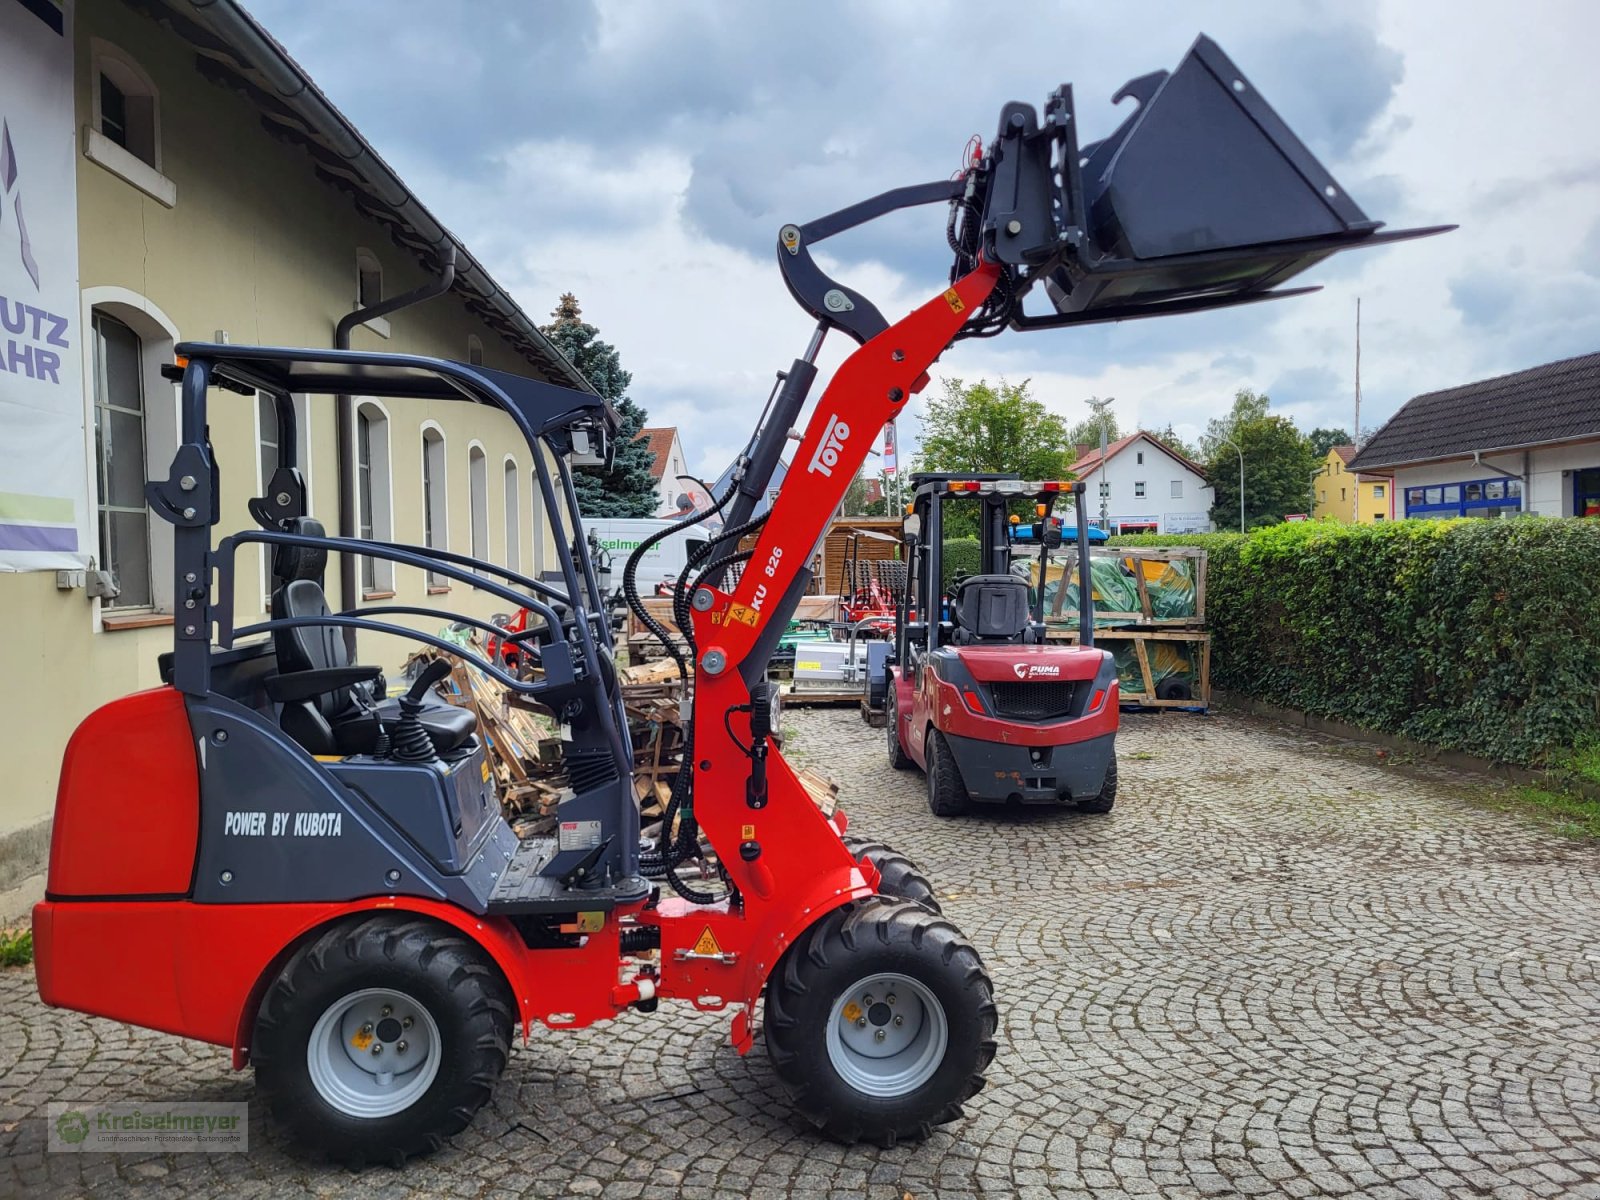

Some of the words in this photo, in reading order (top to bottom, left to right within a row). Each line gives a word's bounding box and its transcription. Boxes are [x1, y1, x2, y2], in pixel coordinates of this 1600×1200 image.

[0, 339, 60, 385] HR
[751, 584, 767, 612] KU
[765, 546, 783, 577] 826
[225, 812, 267, 836] POWER
[271, 812, 290, 836] BY
[294, 812, 342, 836] KUBOTA
